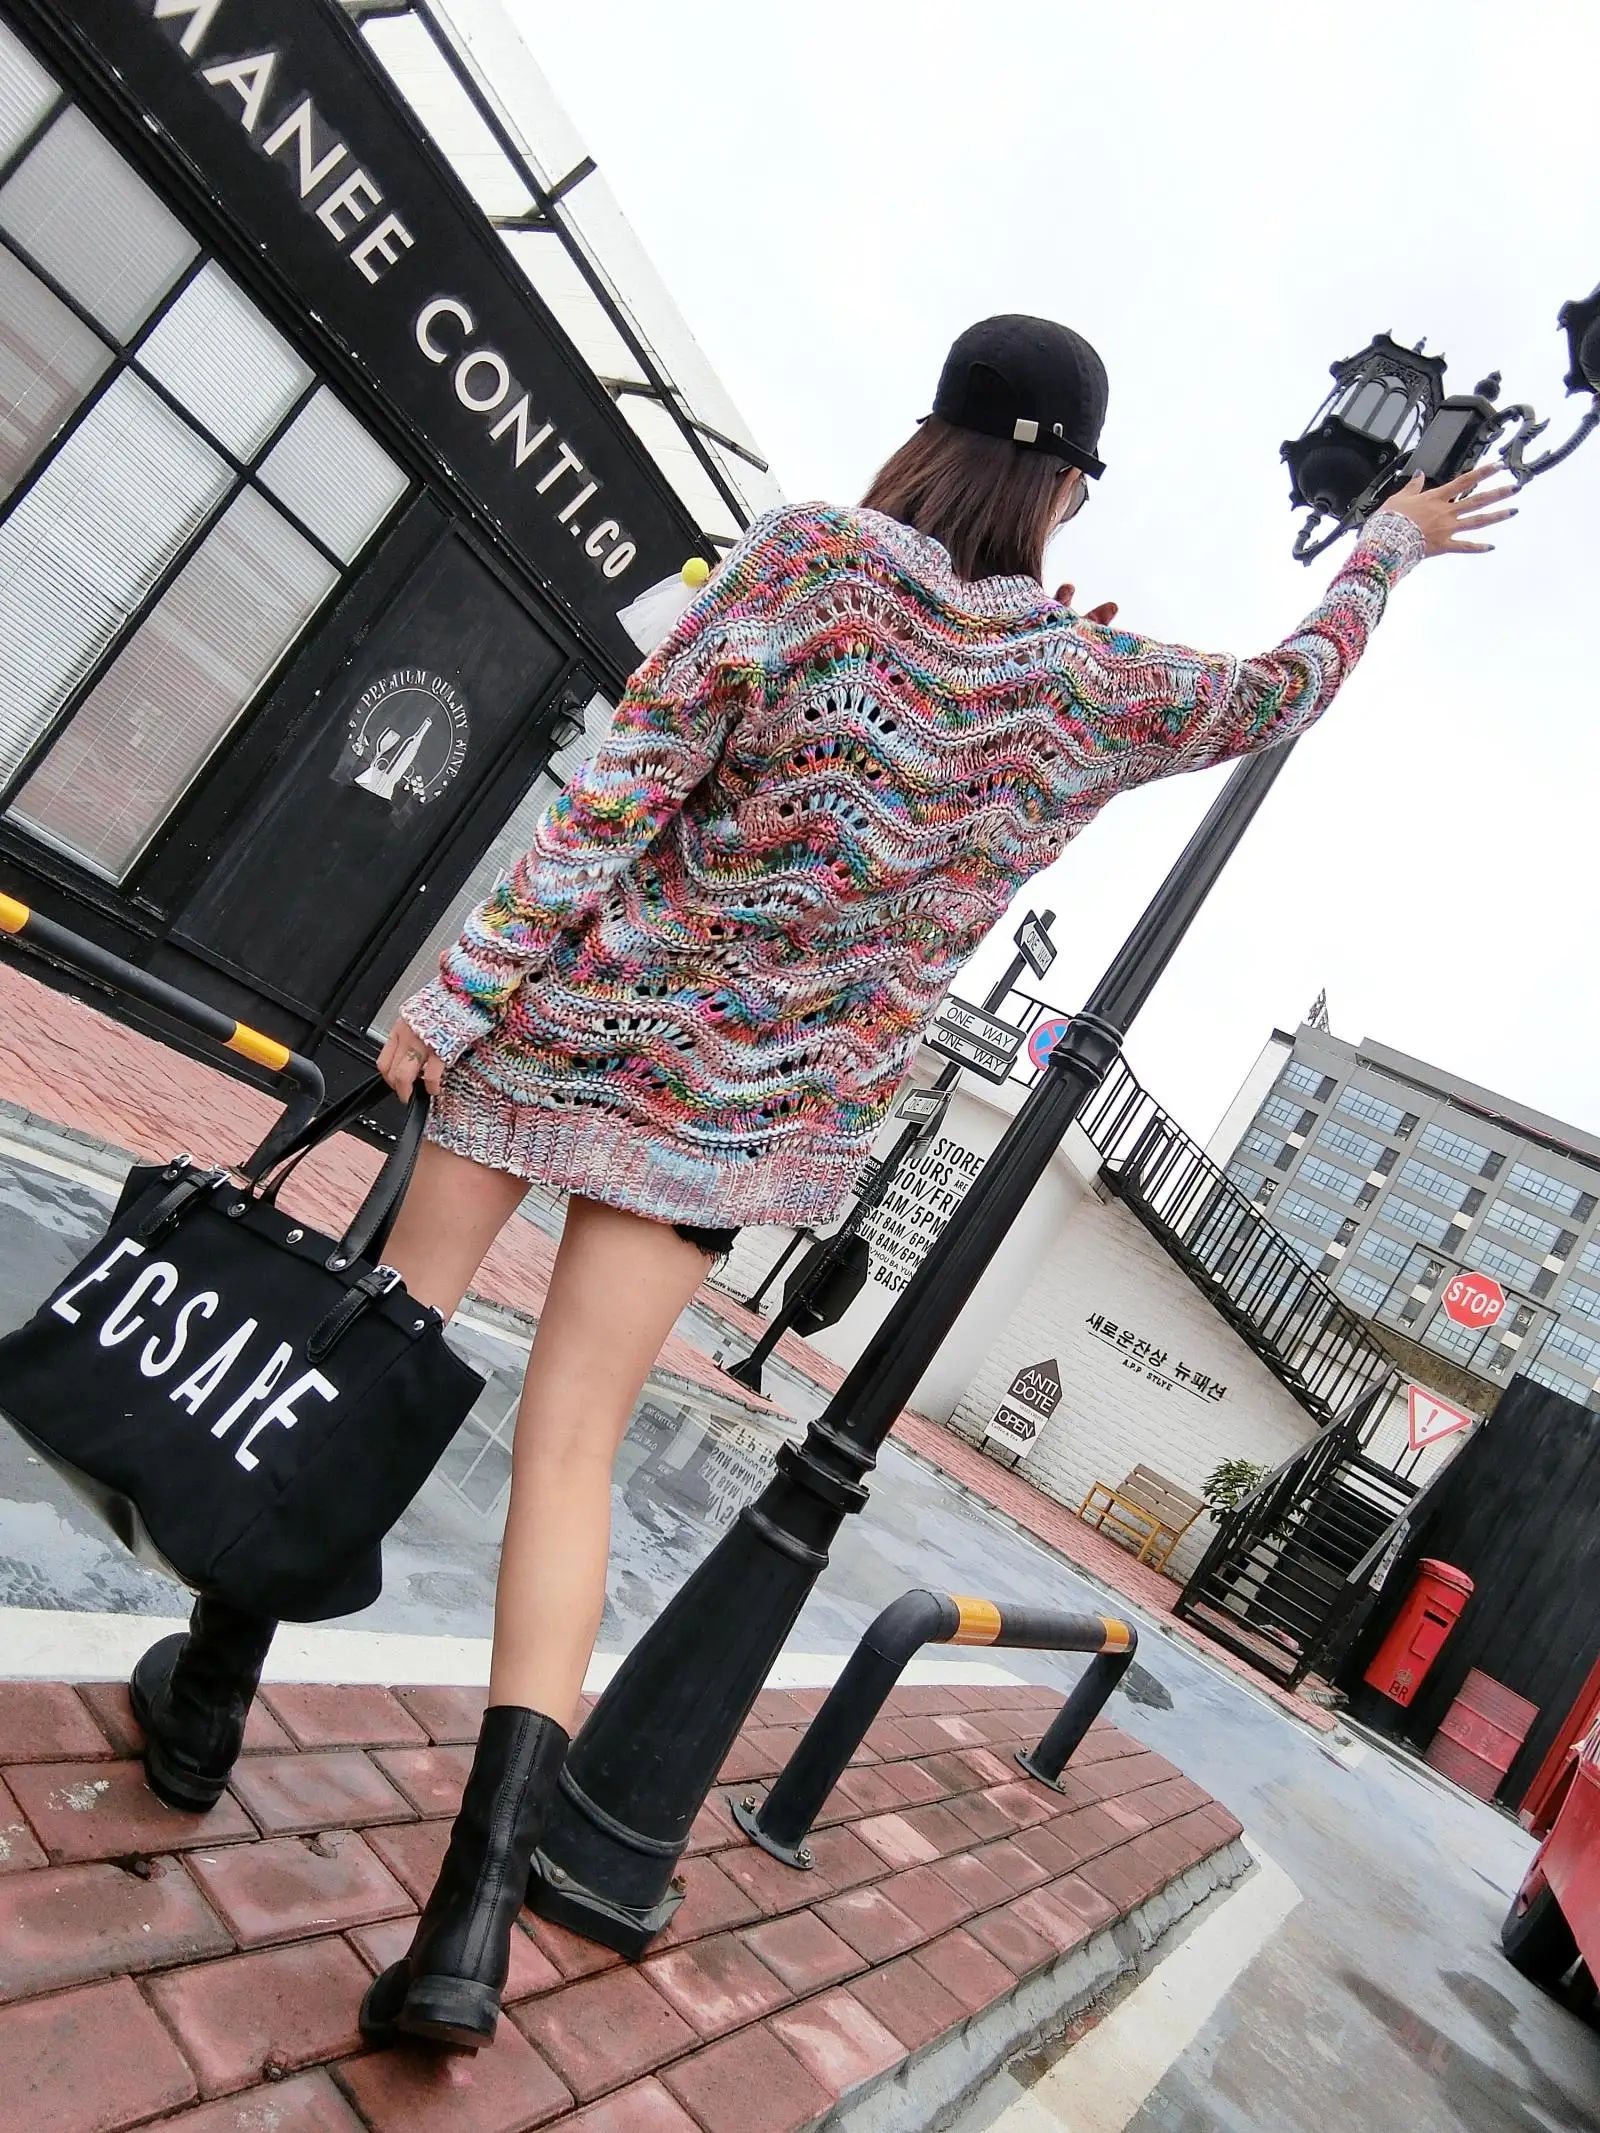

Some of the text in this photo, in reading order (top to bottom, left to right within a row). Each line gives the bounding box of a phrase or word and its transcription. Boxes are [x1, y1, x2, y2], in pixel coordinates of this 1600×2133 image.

[946, 1007, 1014, 1049] ONE WAY
[937, 1030, 1004, 1072] ONE WAY
[934, 1138, 985, 1177] STORE
[953, 1180, 969, 1192] ARE
[882, 1190, 948, 1238] AM/5PM
[1447, 1281, 1500, 1319] STOP
[51, 1237, 339, 1471] ECSAPE
[1012, 1379, 1055, 1413] DOTE
[1022, 1369, 1059, 1397] ANTI
[1146, 1372, 1173, 1392] STLYE
[1175, 1361, 1228, 1402] 뉴패션
[998, 1409, 1034, 1438] OPEN
[1388, 1680, 1409, 1701] ER
